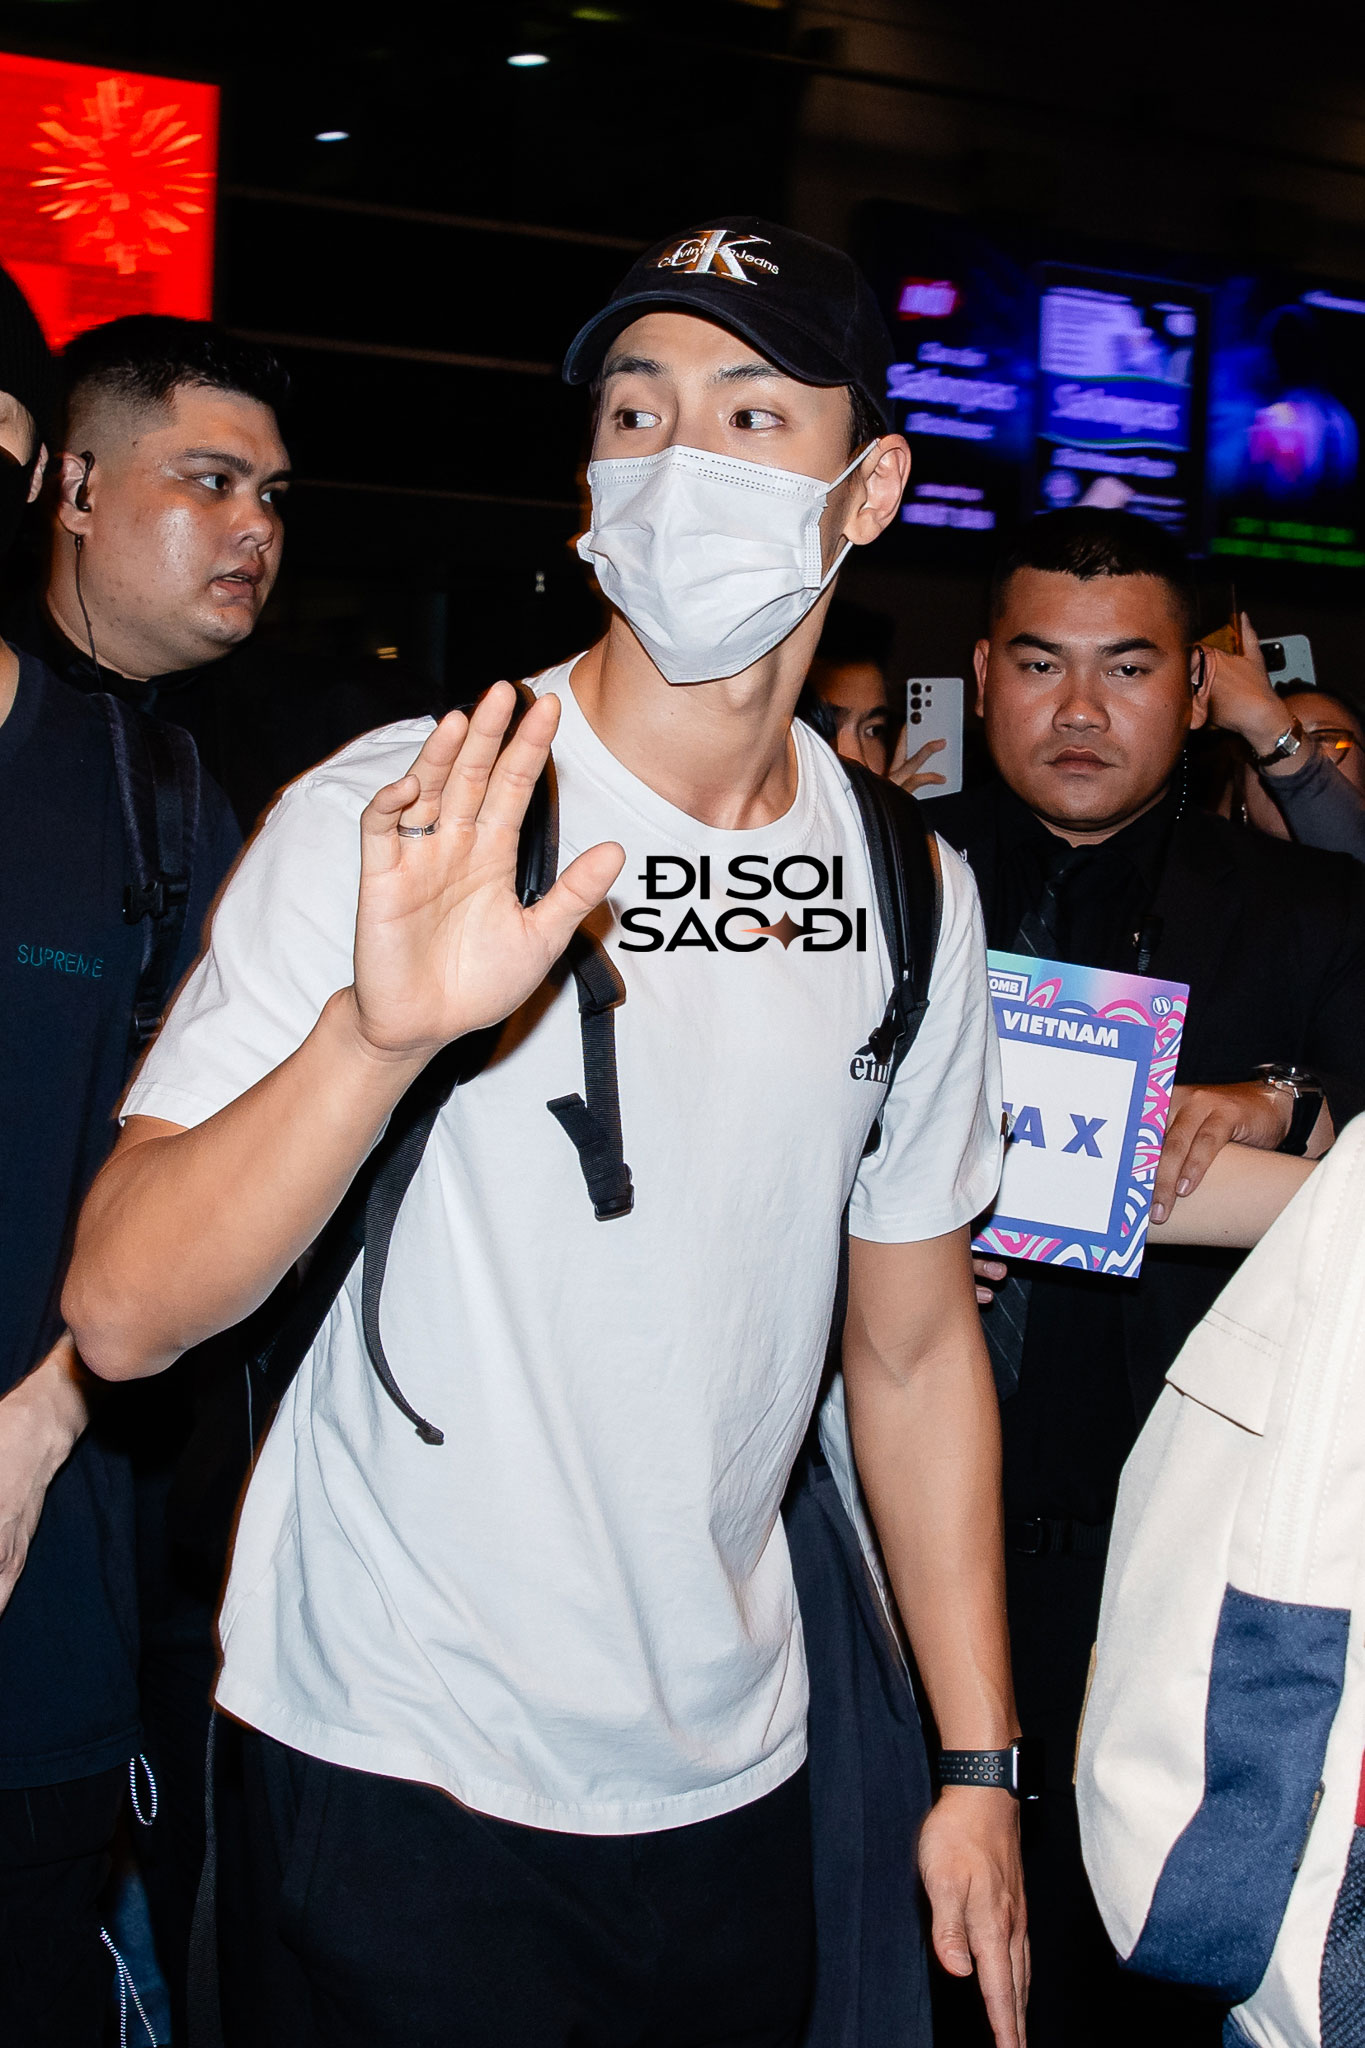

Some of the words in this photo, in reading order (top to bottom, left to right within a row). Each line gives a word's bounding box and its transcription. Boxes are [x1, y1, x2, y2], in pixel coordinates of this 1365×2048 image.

[735, 249, 780, 275] Jeans
[17, 944, 104, 977] SUPREME
[989, 978, 1019, 993] OMB
[1003, 1009, 1119, 1048] VIETNAM
[1061, 1113, 1108, 1158] X
